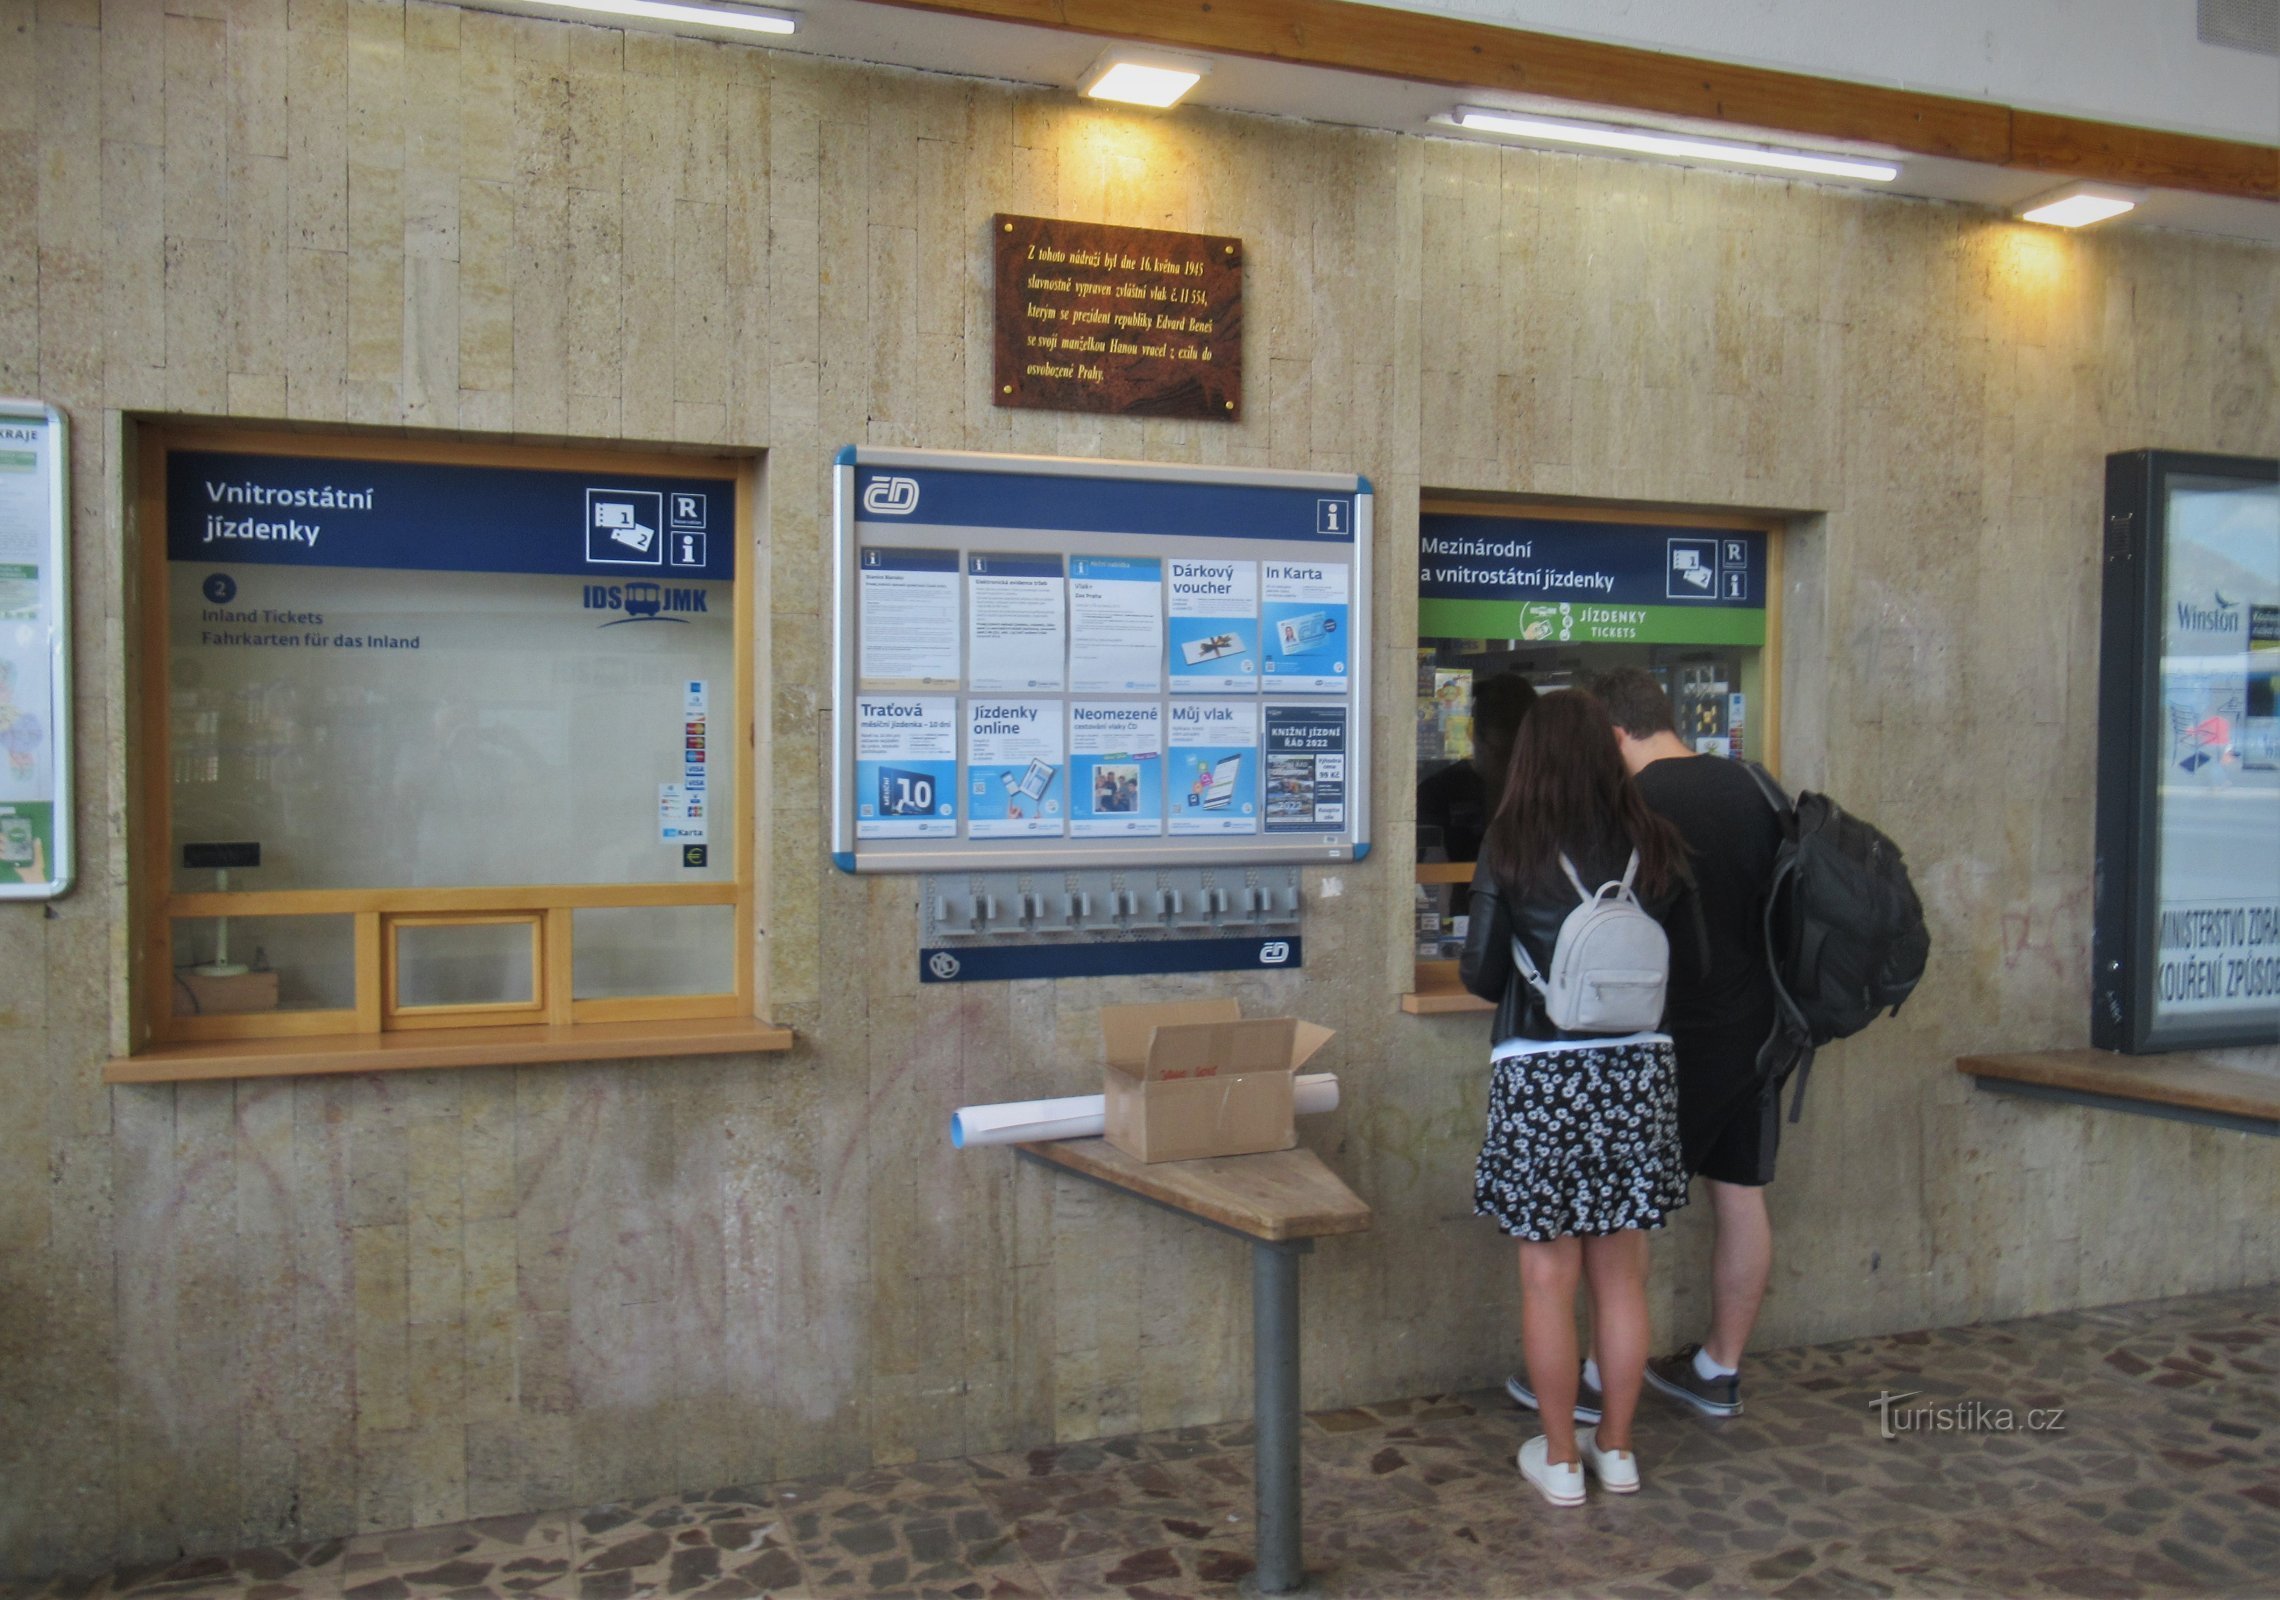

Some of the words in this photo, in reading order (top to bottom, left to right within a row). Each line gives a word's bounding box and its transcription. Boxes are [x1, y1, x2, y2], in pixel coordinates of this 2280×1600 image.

[1028, 245, 1035, 260] Z
[1039, 249, 1065, 262] tohoto
[1070, 249, 1101, 267] nádraží
[1104, 253, 1117, 268] byl
[1121, 255, 1136, 268] dne
[1140, 256, 1152, 272] 16.
[1154, 257, 1180, 273] května
[1185, 261, 1204, 276] 1945
[1028, 275, 1071, 291] slavnostně
[1076, 282, 1111, 297] vypraven
[1116, 281, 1146, 299] zvláštní
[1150, 285, 1166, 301] vlak
[1028, 302, 1055, 321] kterým
[1061, 309, 1069, 319] se
[1072, 307, 1111, 325] prezident
[1115, 312, 1152, 332] republiky
[1156, 314, 1185, 330] Edvard
[1189, 317, 1212, 333] Beneš
[1027, 335, 1036, 346] se
[1037, 334, 1057, 351] svojí
[1061, 337, 1105, 353] manželkou
[1110, 339, 1138, 354] Hanou
[1142, 342, 1166, 357] vracel
[1170, 348, 1175, 358] z
[1178, 343, 1198, 359] exilu
[1202, 346, 1212, 360] do
[1027, 361, 1074, 378] osvobozené
[1078, 364, 1104, 382] Prahy.
[205, 480, 374, 510] Vnitrostátní
[678, 498, 697, 517] R
[203, 515, 321, 546] jízdenky
[1421, 537, 1531, 558] Mezinárodní
[1728, 544, 1741, 559] R
[1173, 564, 1234, 580] Dárkový
[1266, 566, 1279, 578] In
[1284, 567, 1322, 580] Karta
[1421, 570, 1431, 582] a
[1436, 567, 1541, 586] vnitrostátní
[1544, 568, 1614, 592] jízdenky
[213, 581, 226, 598] 2
[1174, 581, 1232, 594] voucher
[583, 585, 622, 609] IDS
[663, 588, 708, 612] JMK
[203, 609, 258, 624] Inland
[263, 610, 323, 624] Tickets
[1580, 608, 1647, 624] JÍZDENKY
[2178, 601, 2239, 632] Winston
[202, 631, 299, 646] Fahrkarten
[304, 632, 329, 647] für
[333, 634, 363, 648] das
[367, 634, 421, 649] Inland
[1591, 626, 1636, 638] TICKETS
[861, 703, 923, 716] Traťová
[974, 705, 1037, 721] Jízdenky
[1074, 708, 1157, 720] Neomezené
[1172, 706, 1199, 723] Můj
[1205, 708, 1232, 720] vlak
[974, 721, 1020, 734] online
[1272, 727, 1306, 736] KNIŽNÍ
[897, 778, 932, 807] 10
